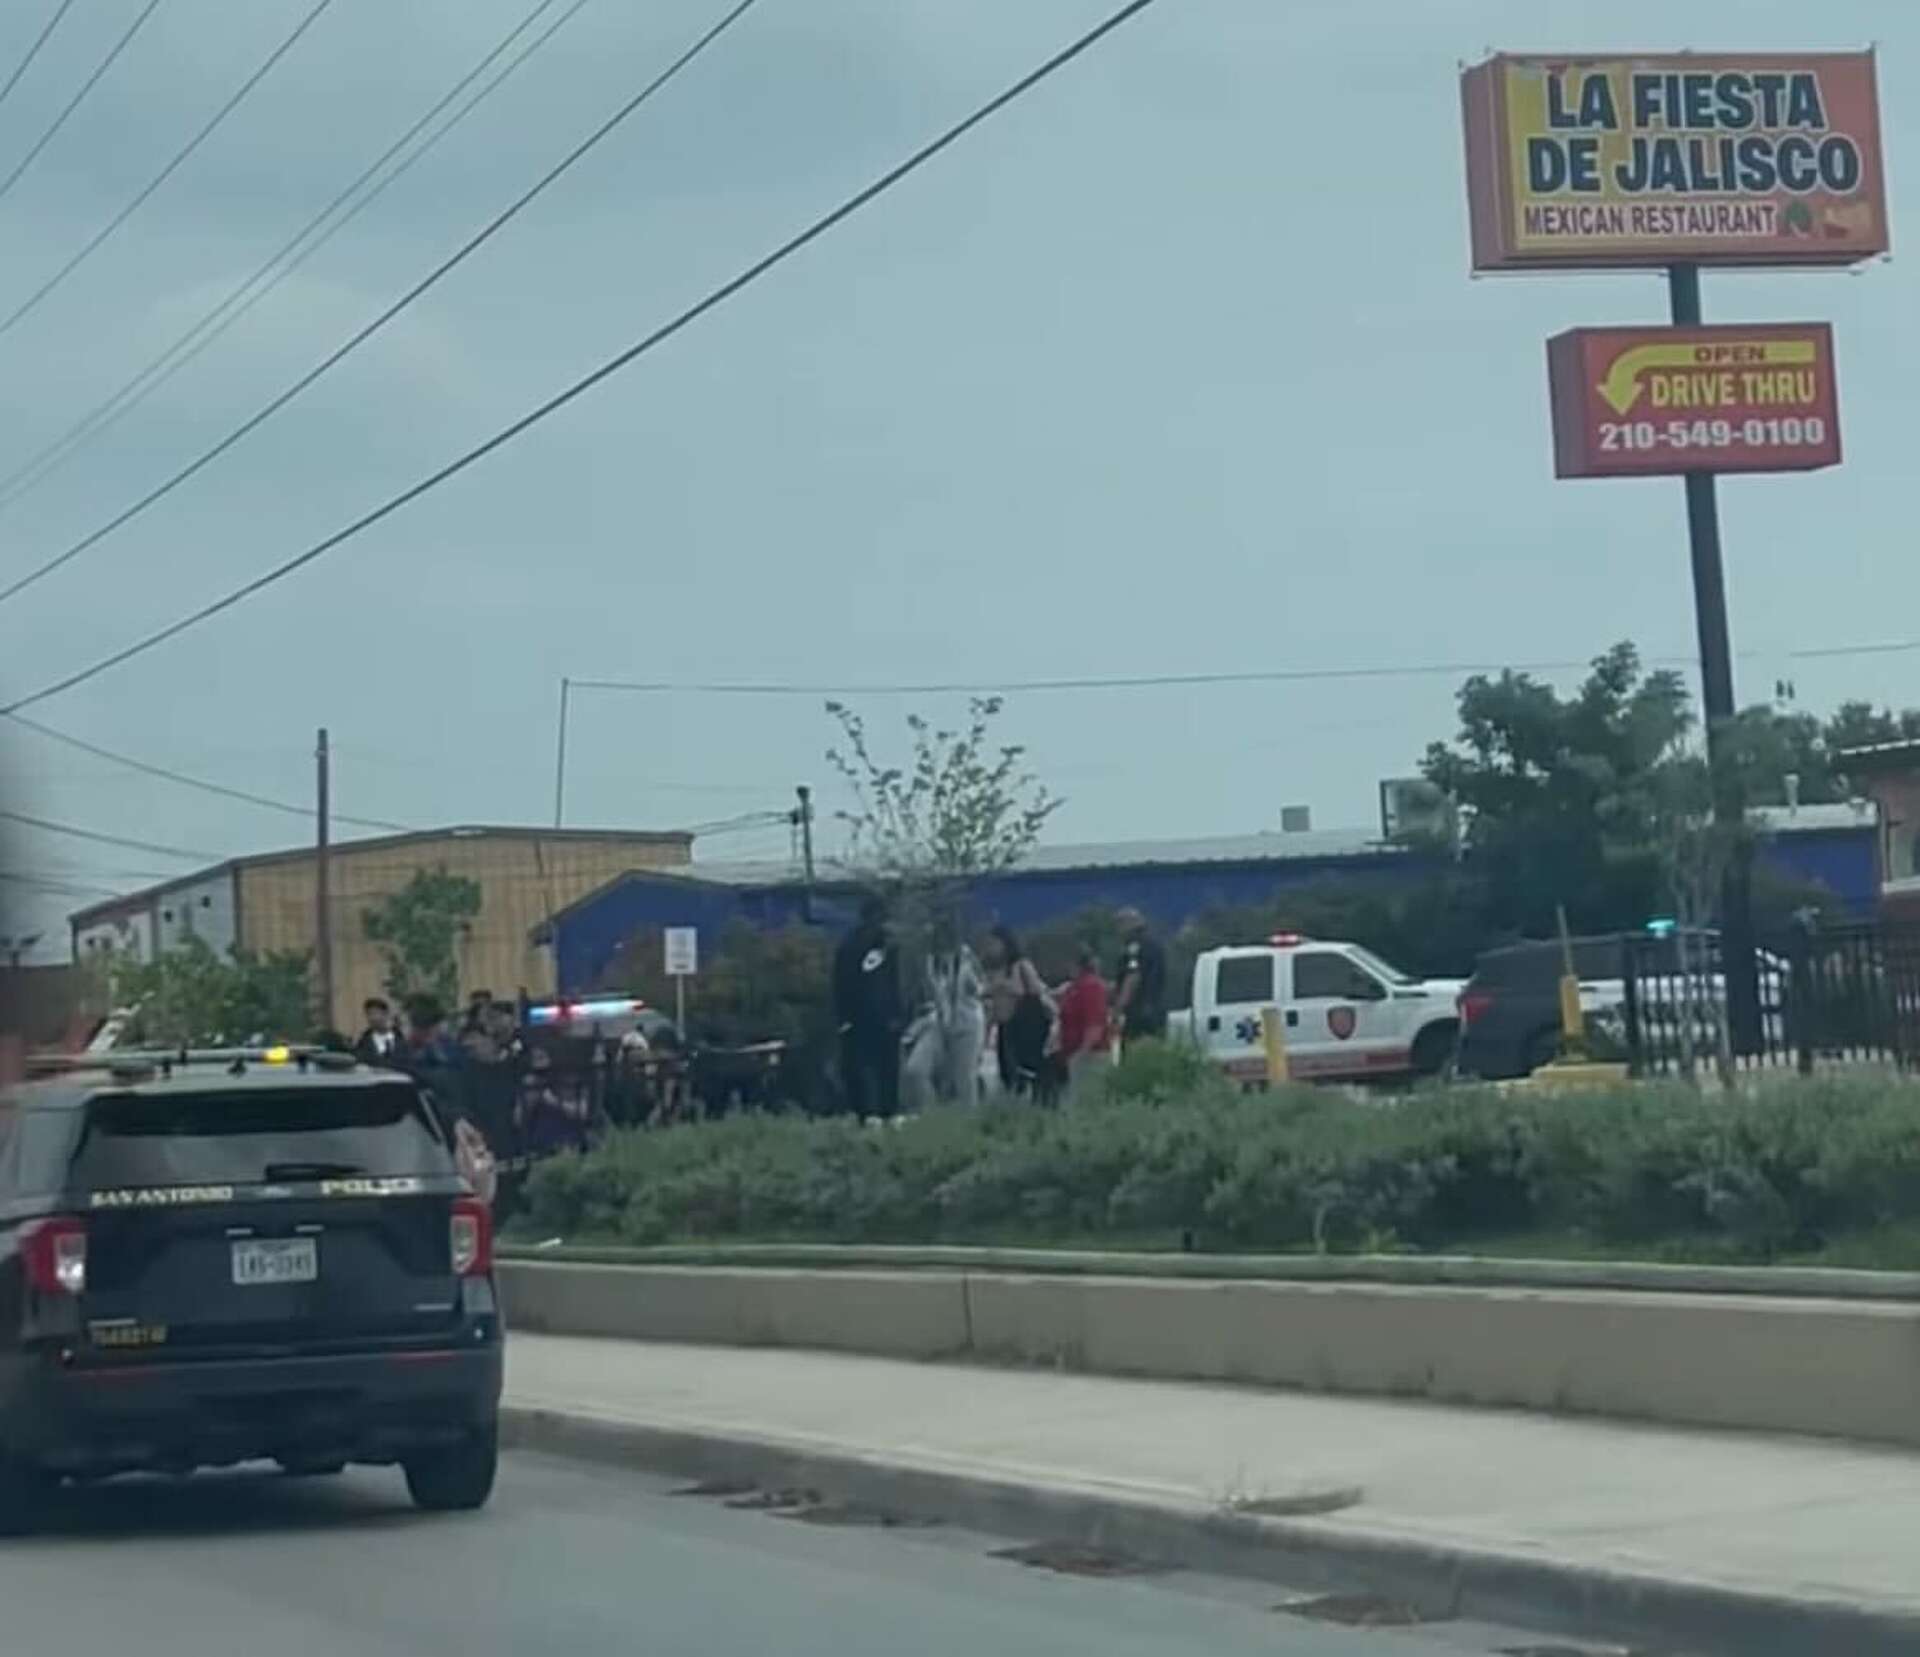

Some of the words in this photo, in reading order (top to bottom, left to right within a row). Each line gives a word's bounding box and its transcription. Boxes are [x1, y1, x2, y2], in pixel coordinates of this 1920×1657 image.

[1546, 73, 1617, 128] LA
[1633, 73, 1825, 128] FIESTA
[1527, 136, 1601, 192] DE
[1614, 135, 1860, 192] JALISCO
[1523, 205, 1624, 235] MEXICAN
[1632, 204, 1775, 234] RESTAURANT
[1693, 345, 1765, 362] OPEN
[1651, 372, 1735, 408] DRIVE
[1741, 370, 1816, 405] THRU
[1599, 417, 1825, 450] 210-549-0100
